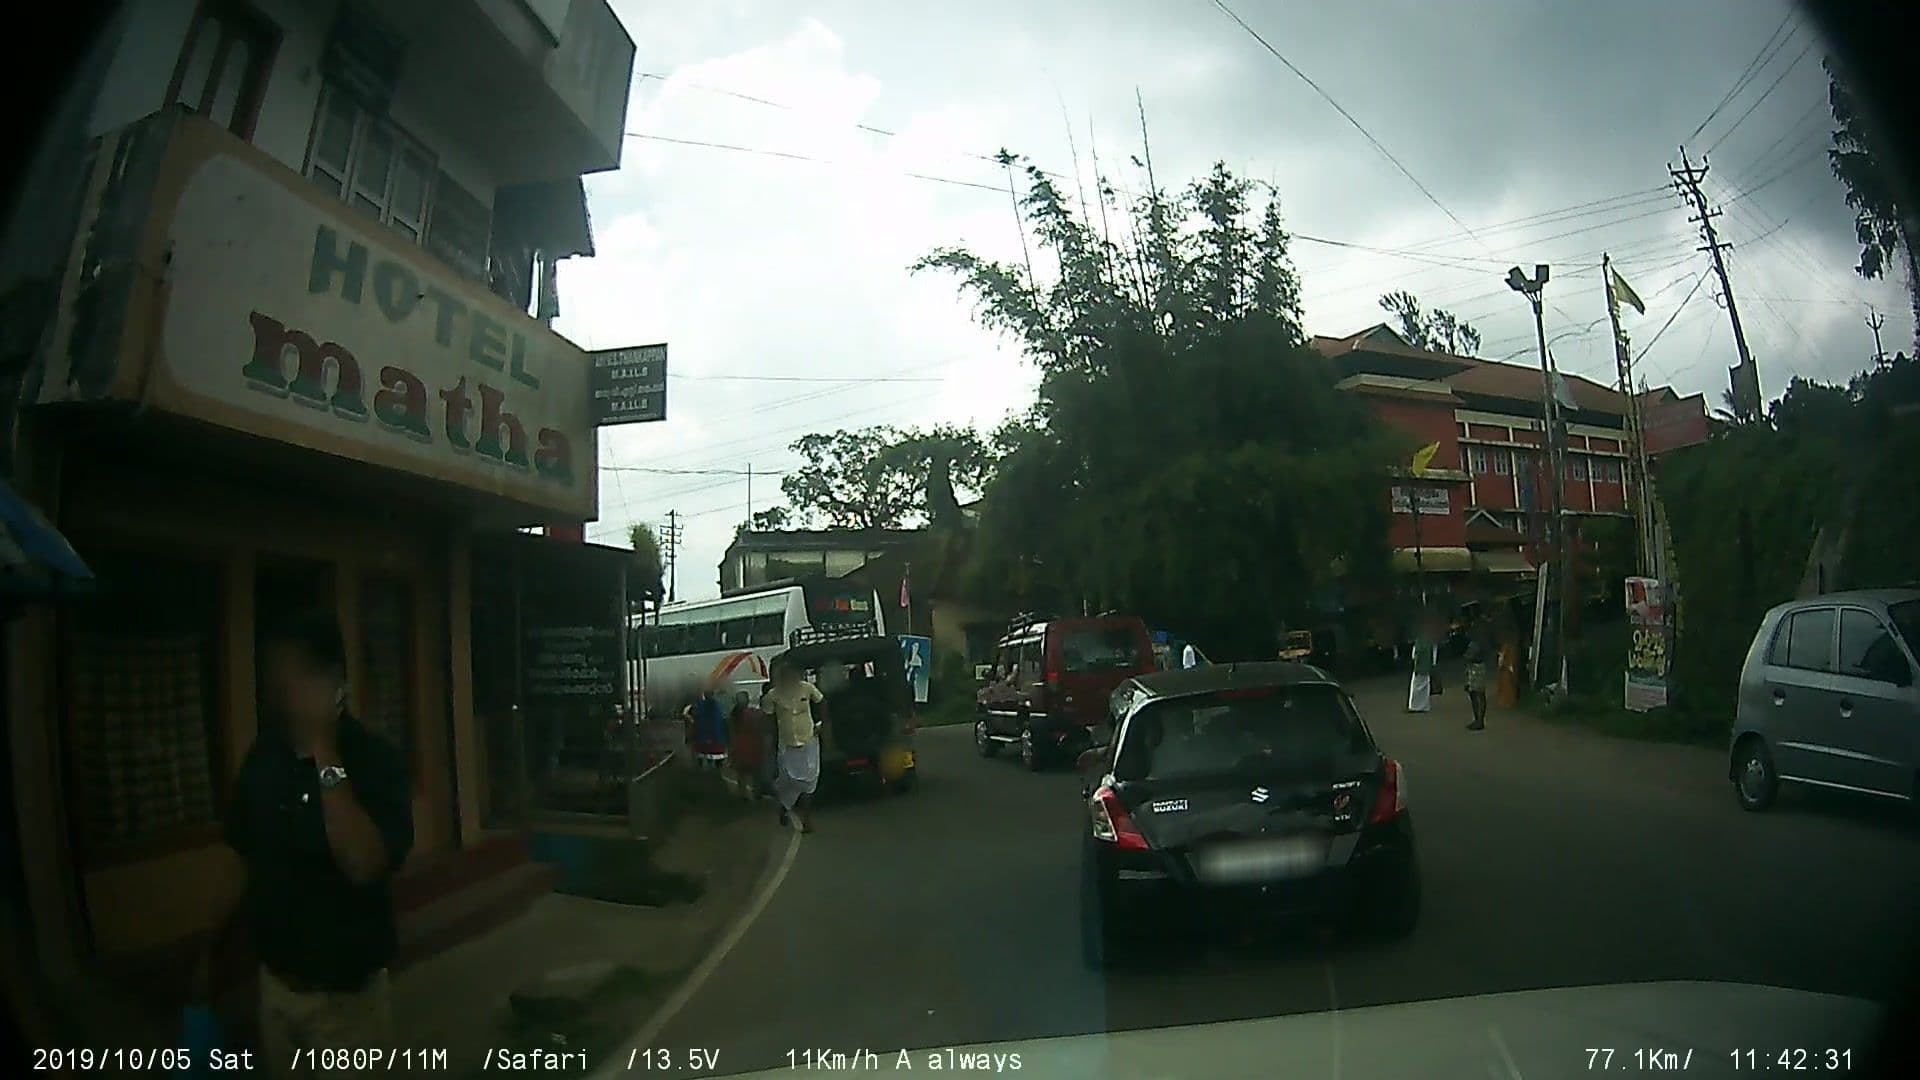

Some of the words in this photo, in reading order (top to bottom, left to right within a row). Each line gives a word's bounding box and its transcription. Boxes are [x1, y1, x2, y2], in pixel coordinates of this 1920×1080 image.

[307, 223, 540, 391] HOTEL
[243, 309, 575, 484] matha
[1153, 799, 1188, 813] SUZUKI
